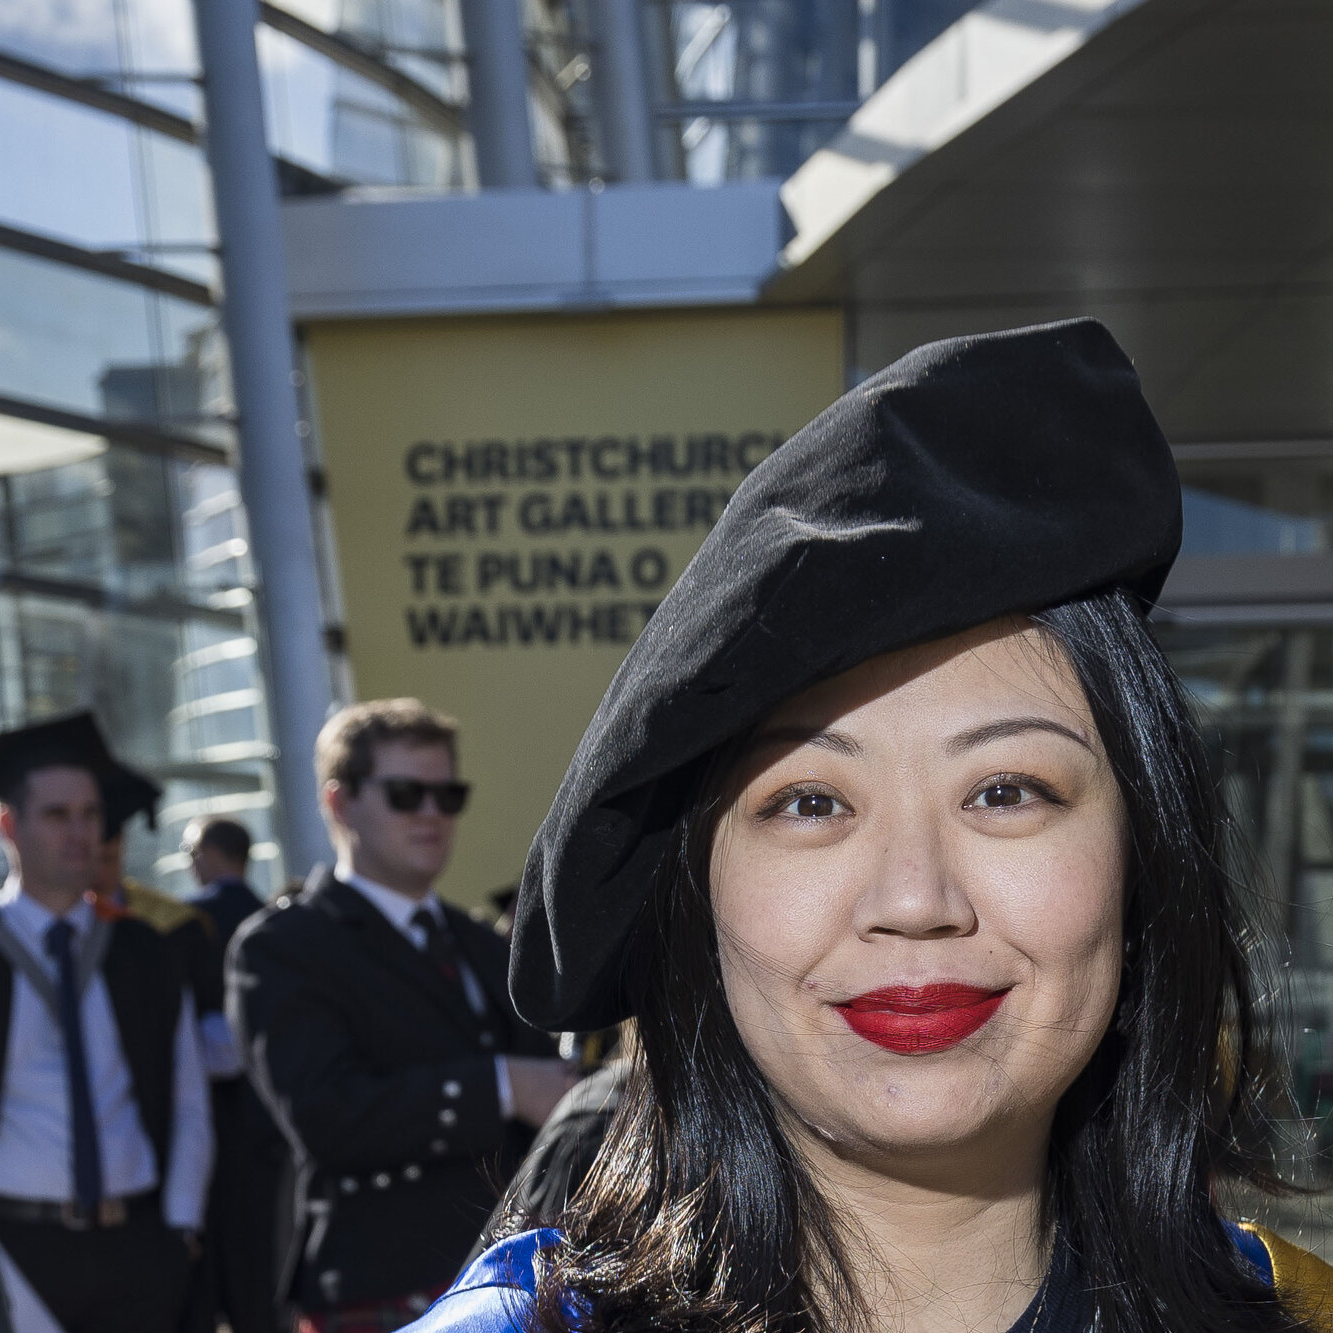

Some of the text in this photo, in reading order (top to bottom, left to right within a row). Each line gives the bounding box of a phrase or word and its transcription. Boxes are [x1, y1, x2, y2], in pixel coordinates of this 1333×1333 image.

[408, 496, 501, 536] ART
[406, 547, 667, 594] TE PUNA O
